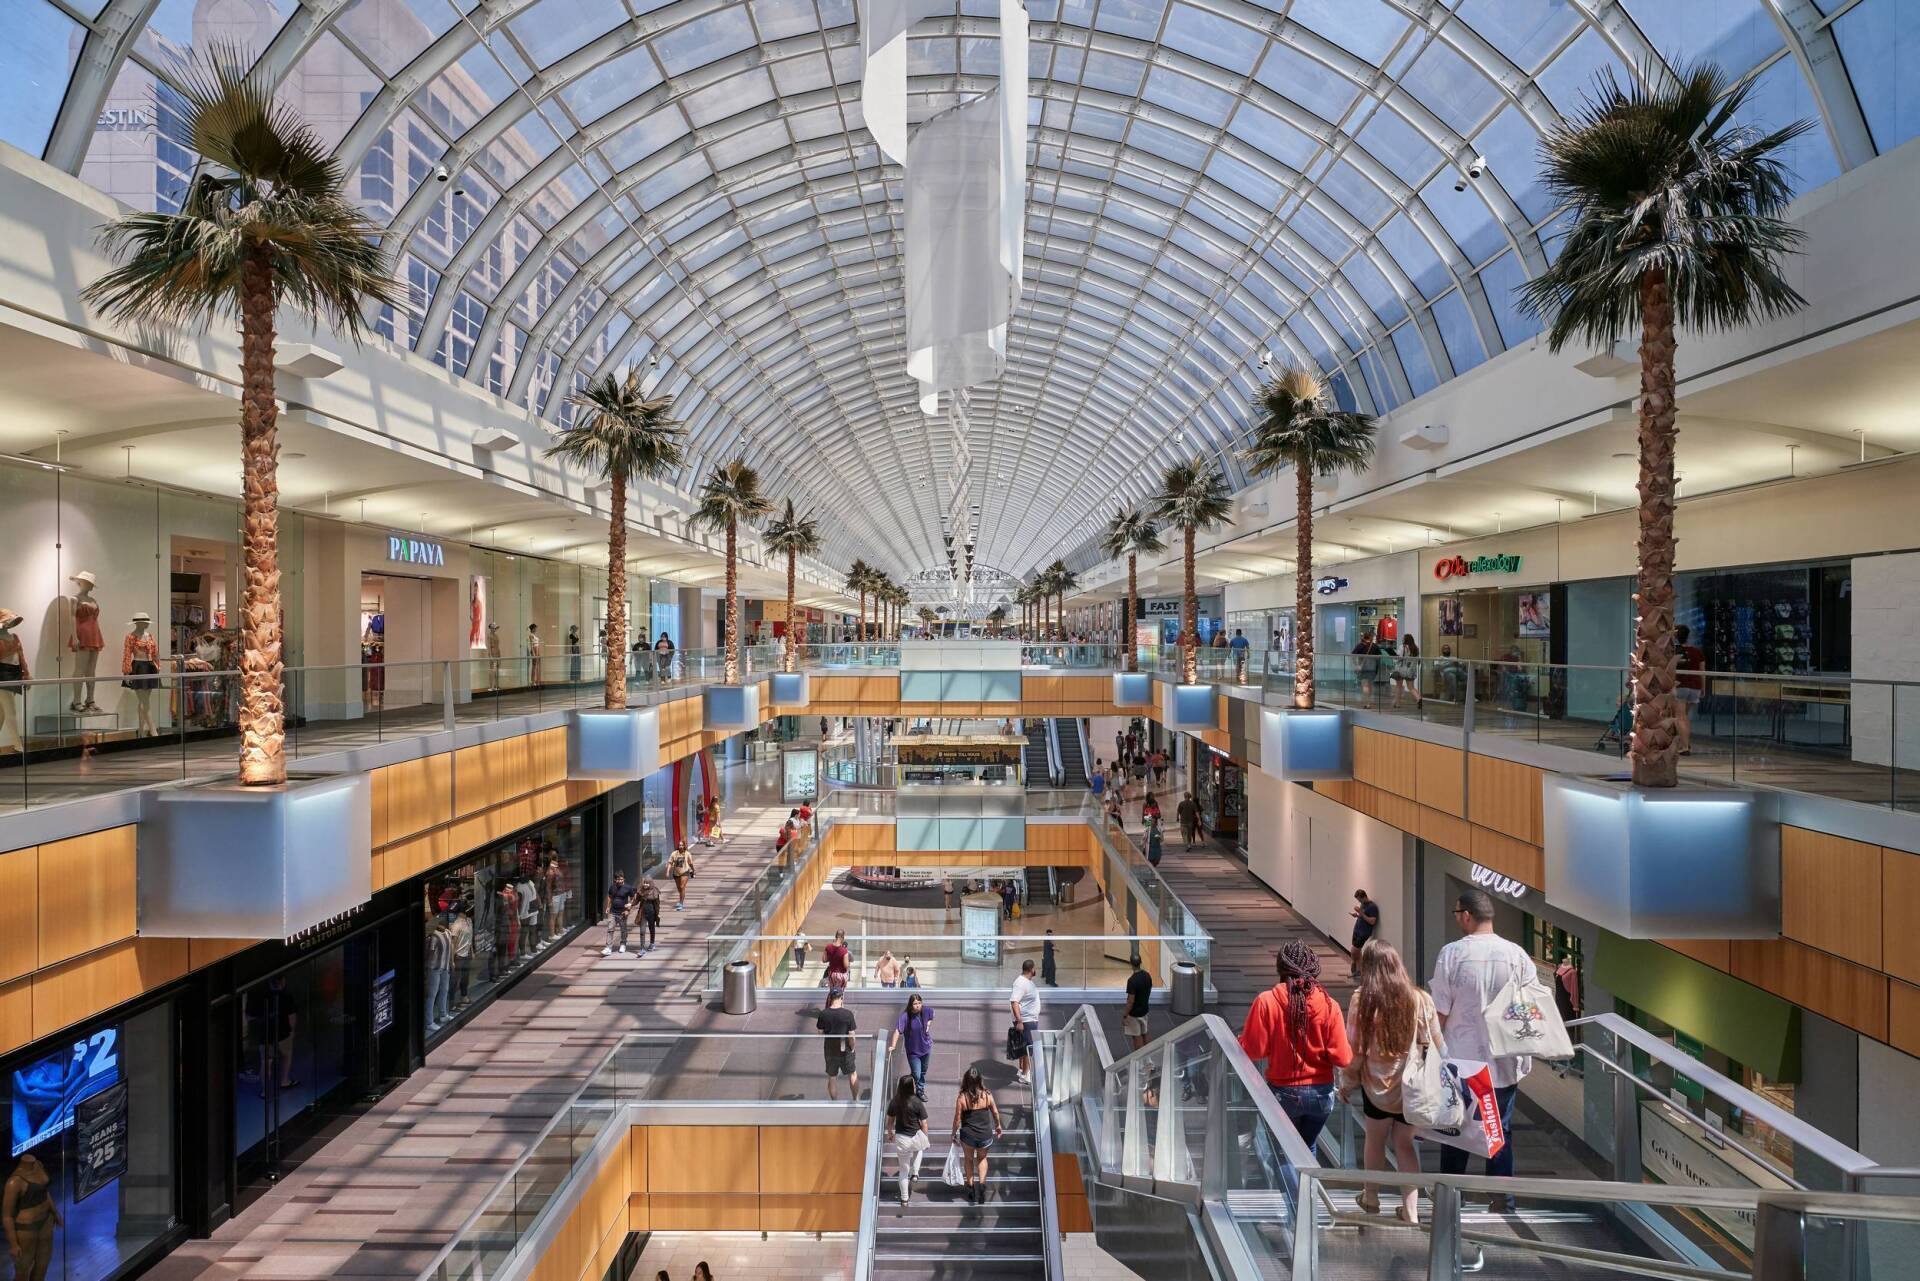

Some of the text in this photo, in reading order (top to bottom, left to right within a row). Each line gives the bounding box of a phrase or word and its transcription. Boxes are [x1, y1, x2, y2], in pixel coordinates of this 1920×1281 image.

[389, 536, 444, 566] PAPAYA
[1150, 602, 1179, 611] FAST
[89, 1122, 118, 1145] JEANS
[87, 1140, 115, 1169] $25
[1651, 1138, 1668, 1160] Get
[1671, 1152, 1682, 1171] in
